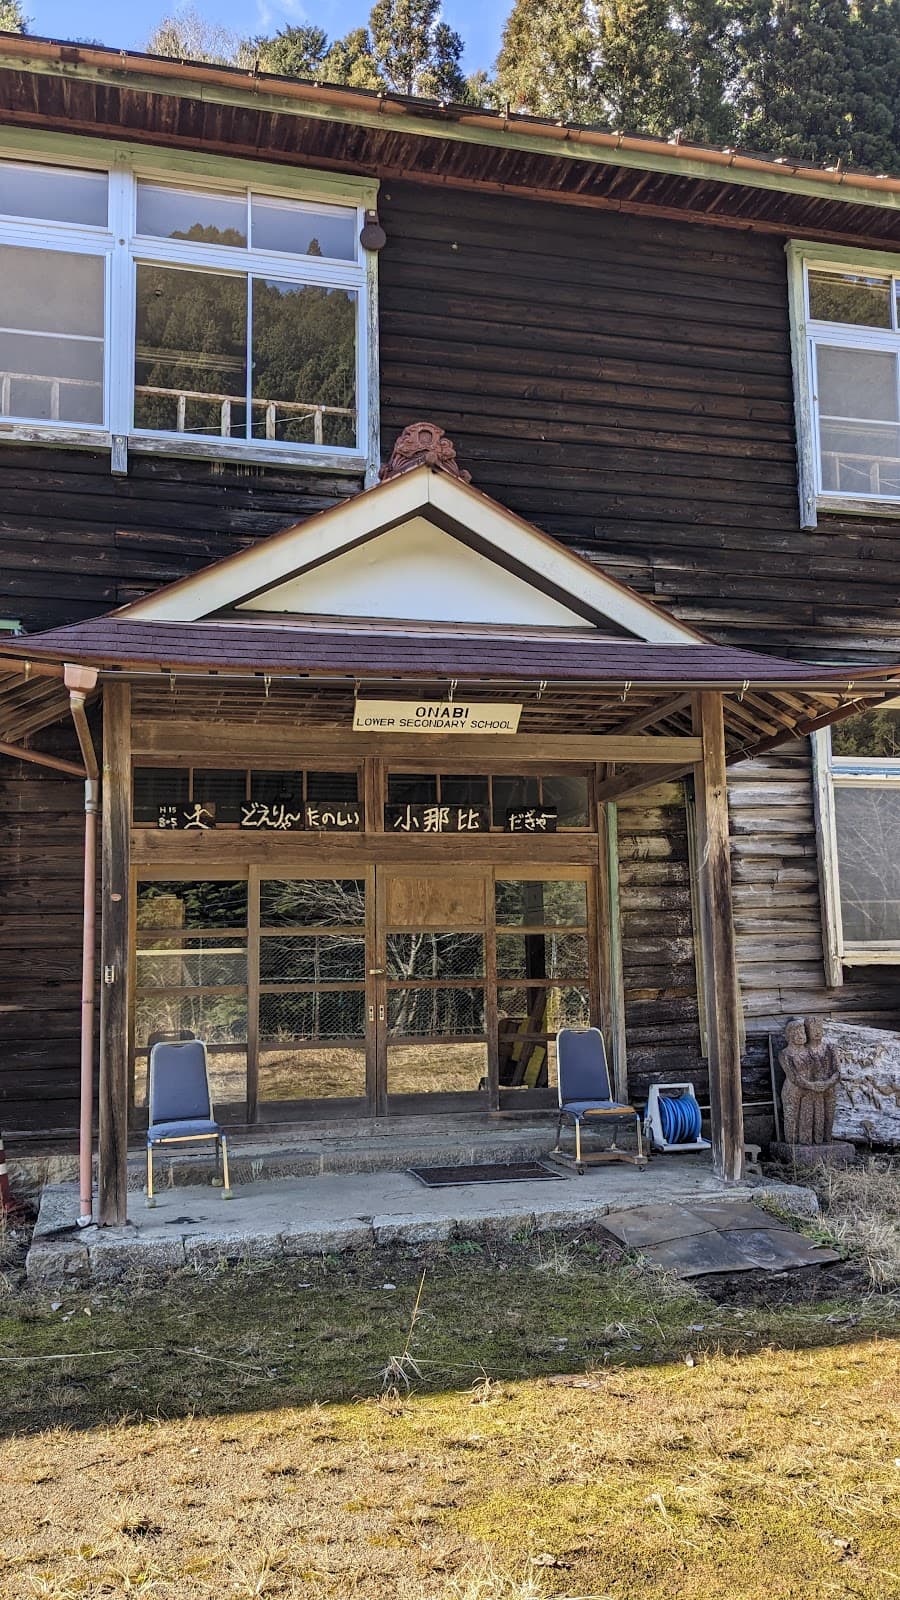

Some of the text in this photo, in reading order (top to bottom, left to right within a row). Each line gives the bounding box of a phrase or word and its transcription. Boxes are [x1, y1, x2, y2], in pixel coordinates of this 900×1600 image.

[415, 706, 470, 719] ONABI
[356, 718, 514, 730] LOWER SECONDARY SCHOOL
[306, 807, 360, 827] たのしい
[393, 804, 480, 833] 小那比
